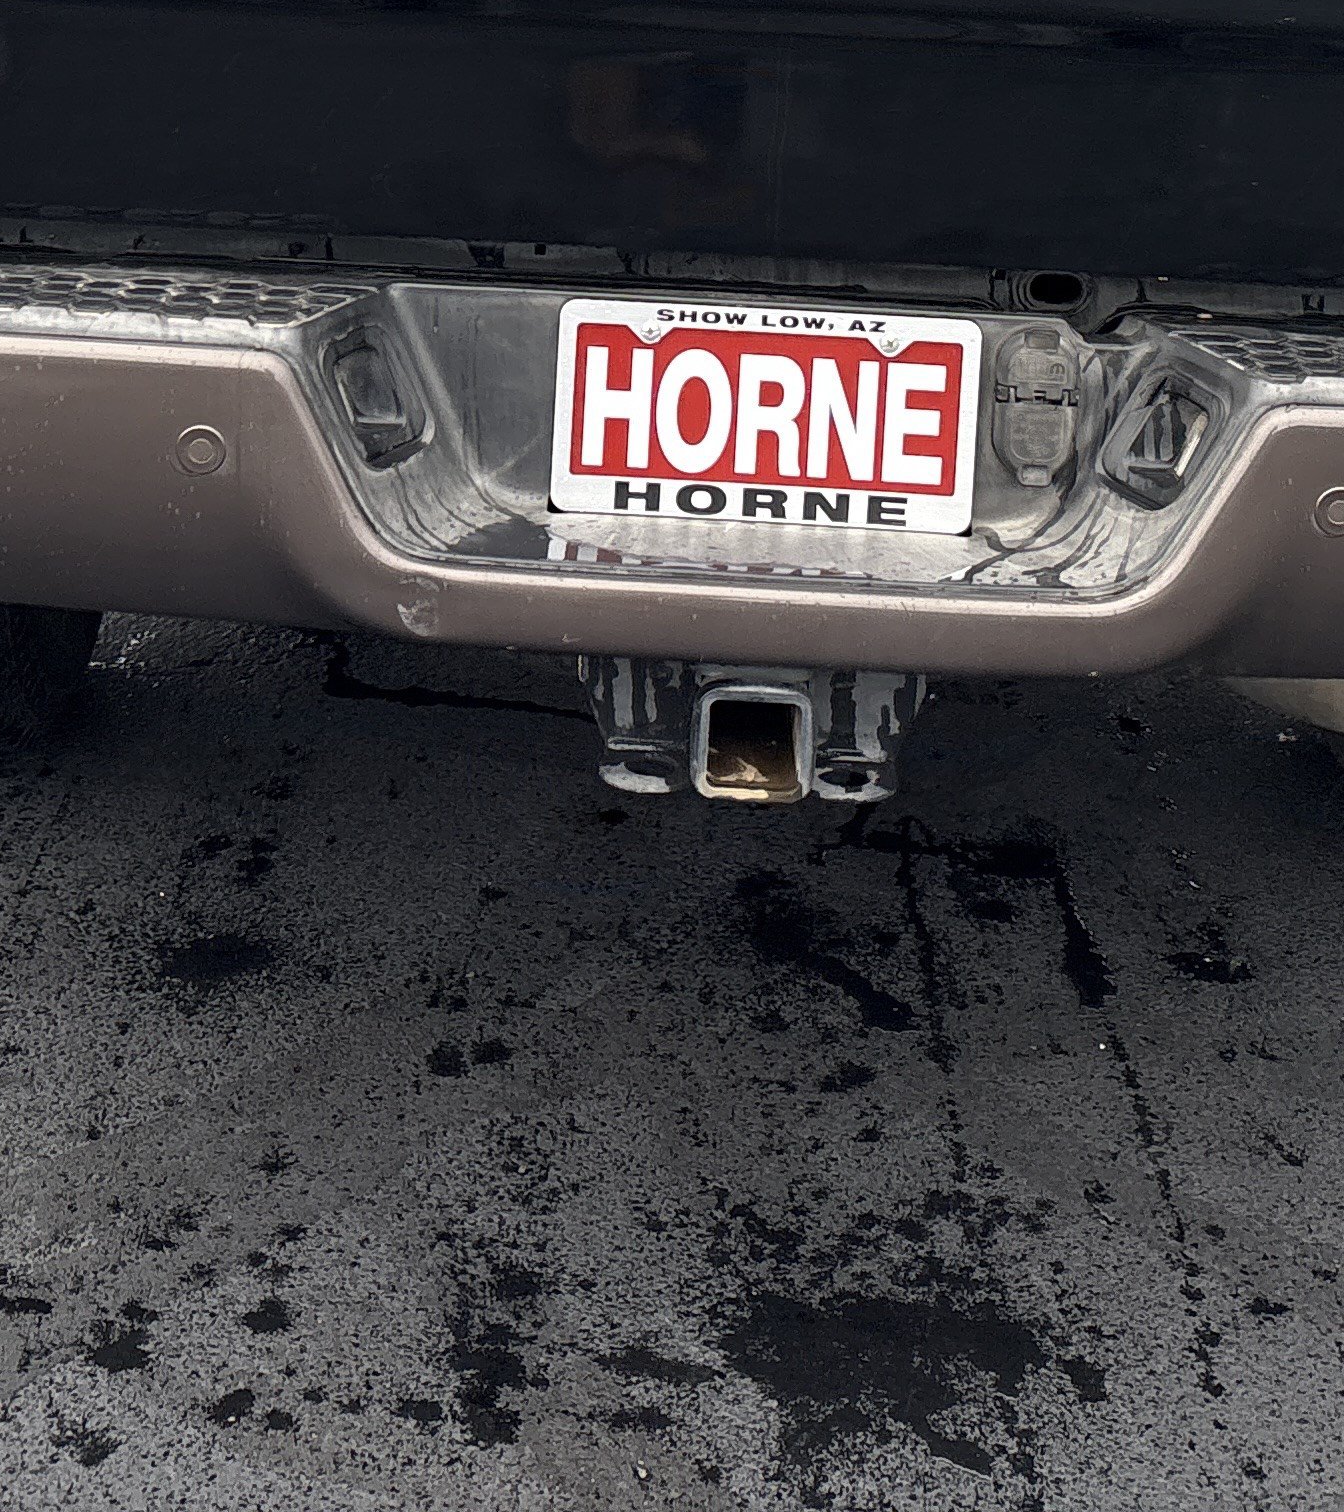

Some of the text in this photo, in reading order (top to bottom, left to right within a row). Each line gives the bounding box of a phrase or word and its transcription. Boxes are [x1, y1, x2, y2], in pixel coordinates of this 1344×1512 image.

[656, 308, 887, 334] SHOW LOW, AZ
[580, 344, 948, 486] HORNE
[613, 481, 909, 527] HORNE
